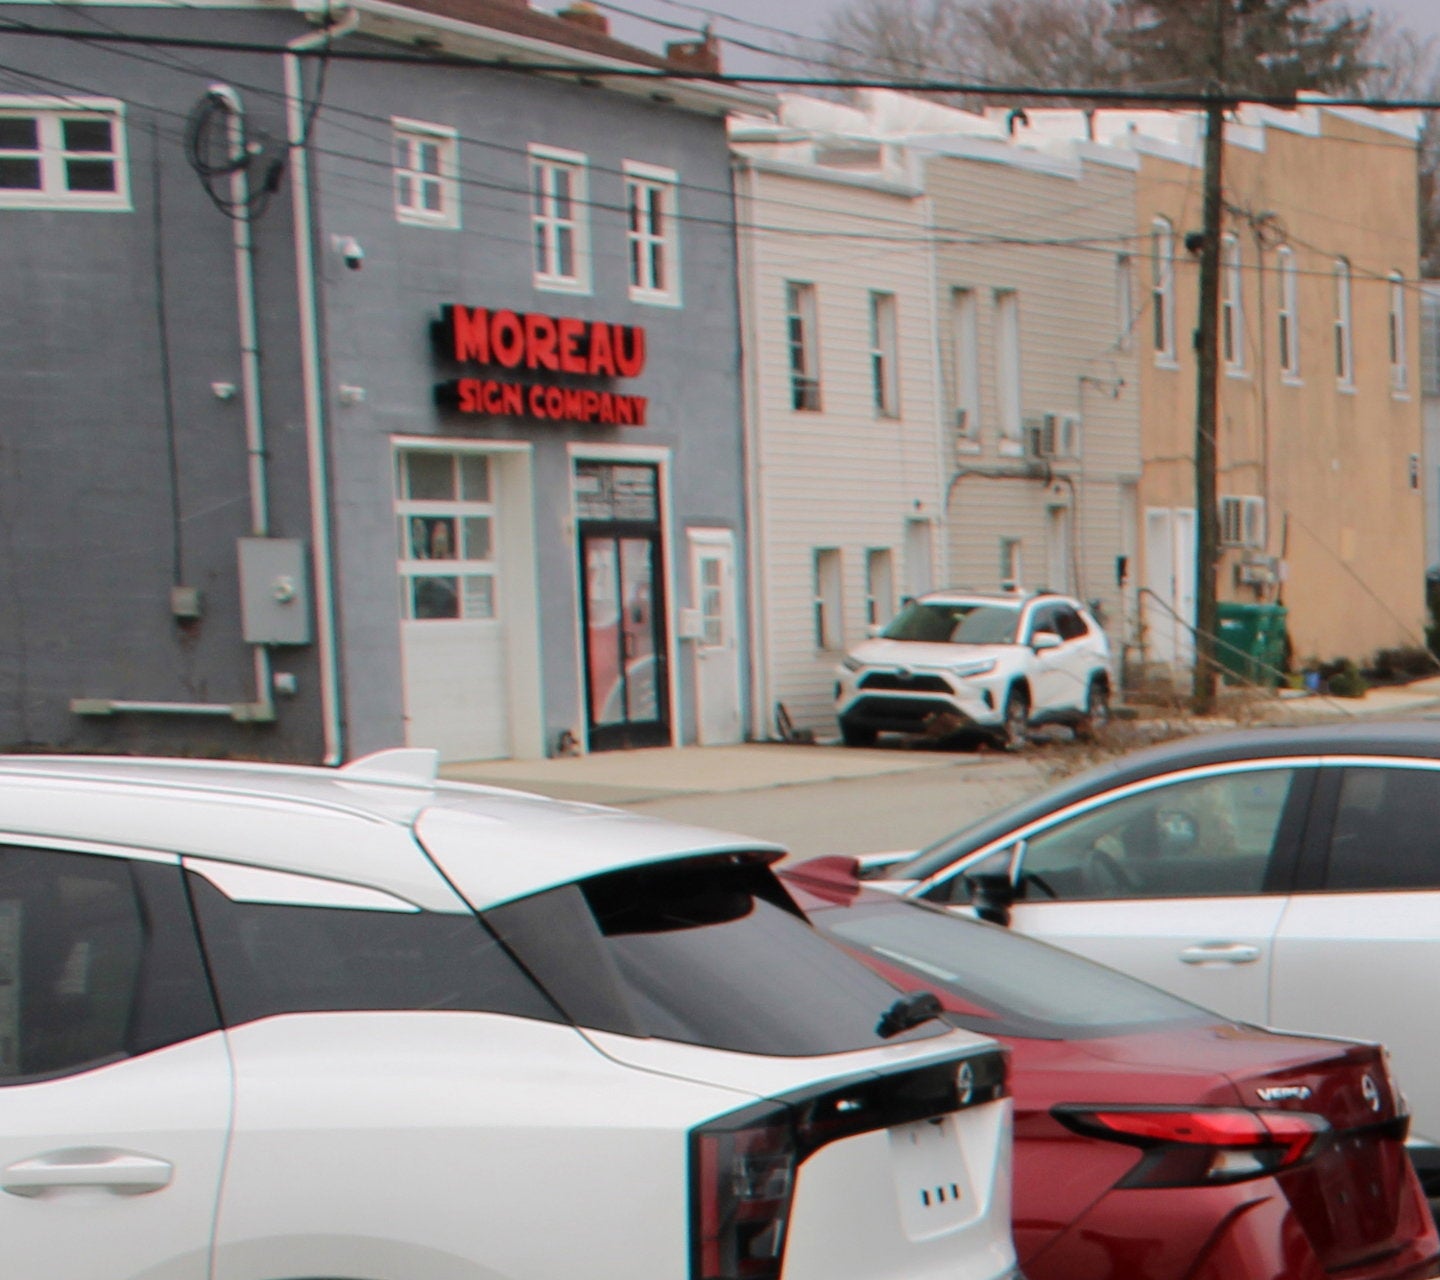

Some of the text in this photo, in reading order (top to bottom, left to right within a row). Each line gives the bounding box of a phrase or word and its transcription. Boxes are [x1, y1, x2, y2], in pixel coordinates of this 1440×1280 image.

[453, 304, 645, 378] MOREAU
[457, 377, 648, 426] SIGN COMPANY
